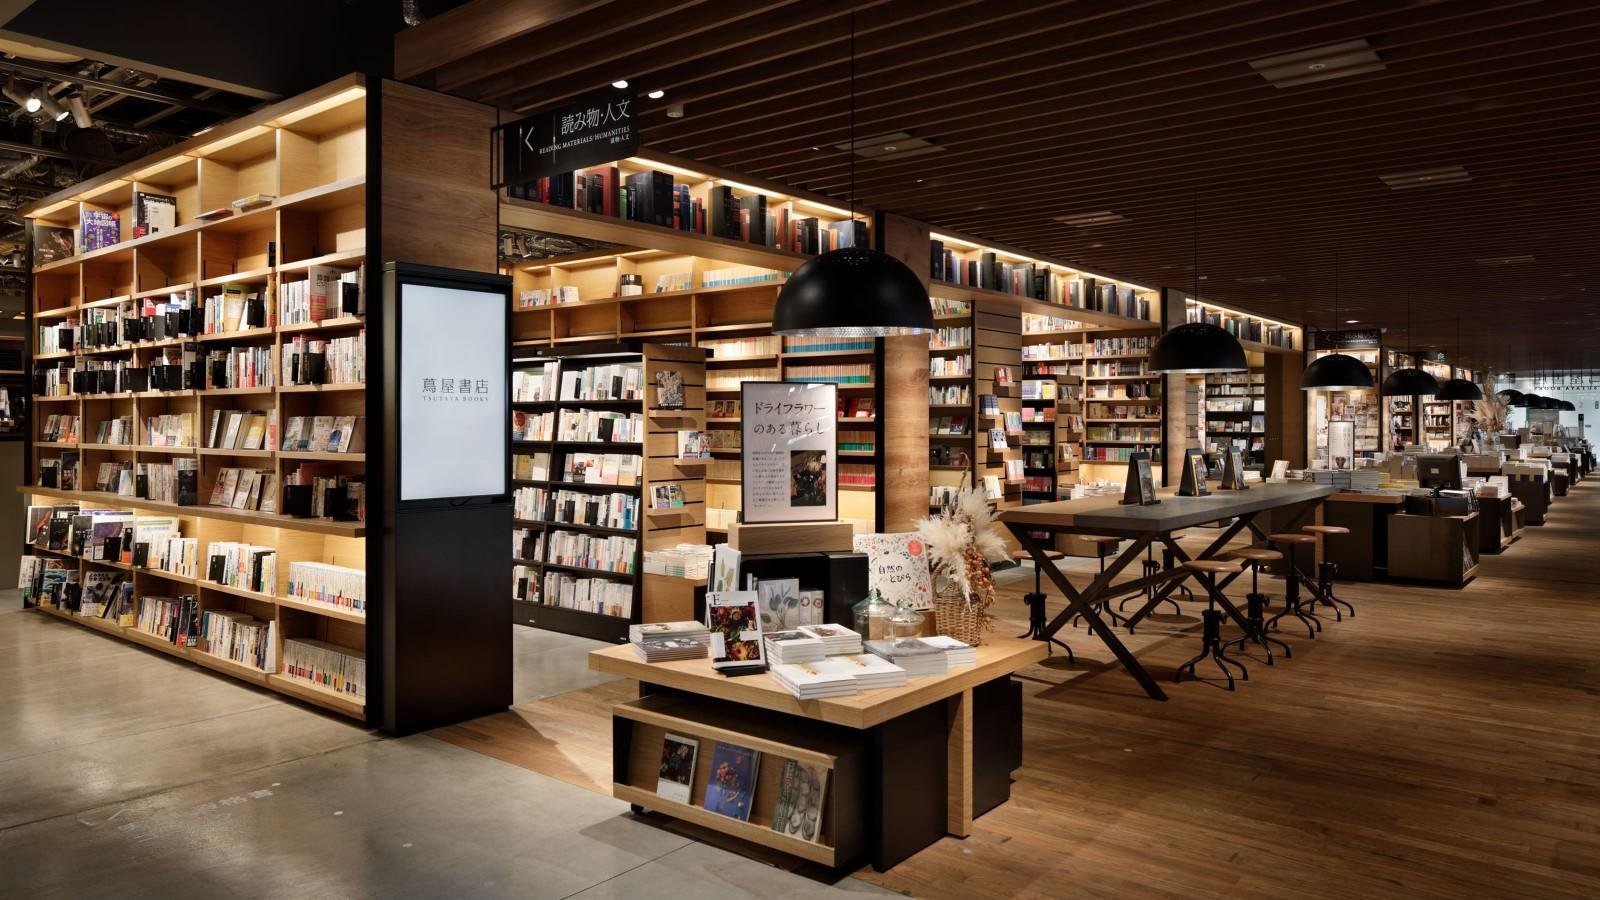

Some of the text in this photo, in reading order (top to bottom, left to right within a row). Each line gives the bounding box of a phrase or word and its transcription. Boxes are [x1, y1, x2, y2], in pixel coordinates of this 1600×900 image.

[539, 143, 562, 155] READING
[422, 377, 489, 394] 蔦屋書店
[755, 402, 826, 415] ドライフラワー
